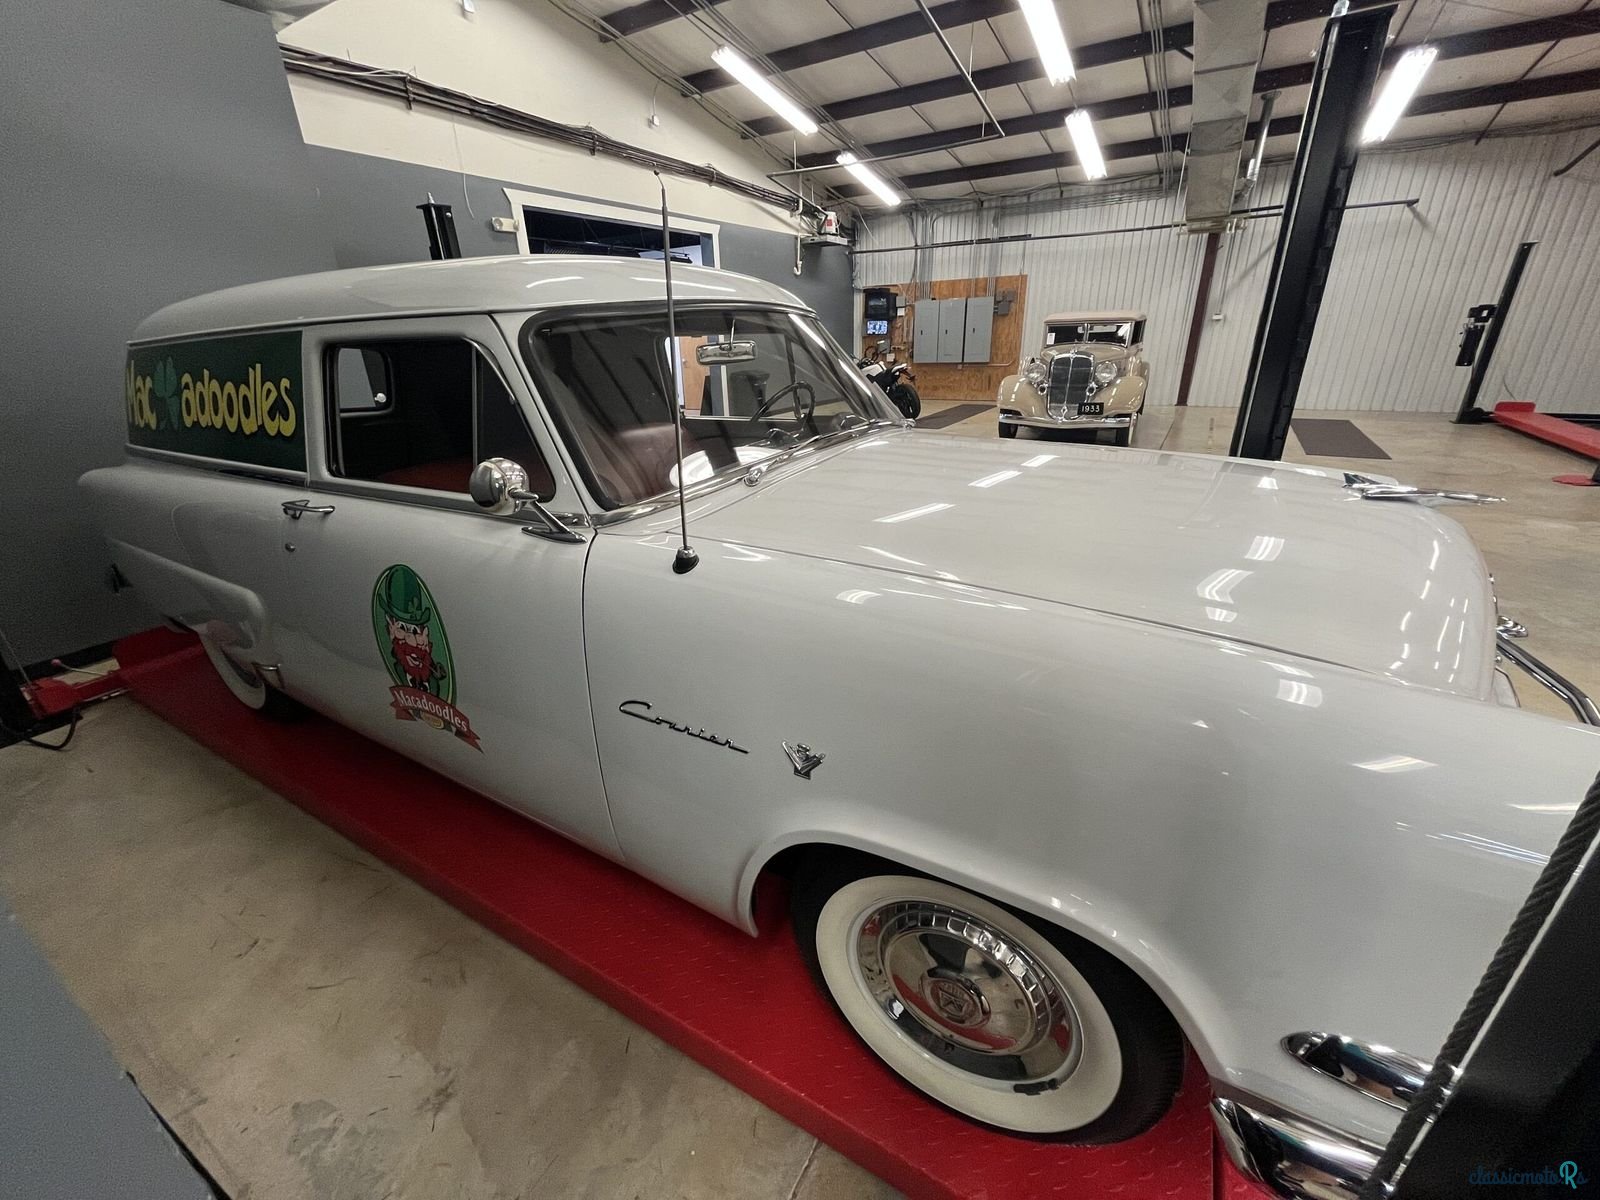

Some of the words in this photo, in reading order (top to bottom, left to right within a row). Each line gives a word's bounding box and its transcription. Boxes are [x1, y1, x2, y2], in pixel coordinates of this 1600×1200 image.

[181, 363, 296, 436] adoodles
[1081, 405, 1101, 413] 1933
[394, 690, 468, 732] Macadoodles
[619, 700, 749, 754] Courier
